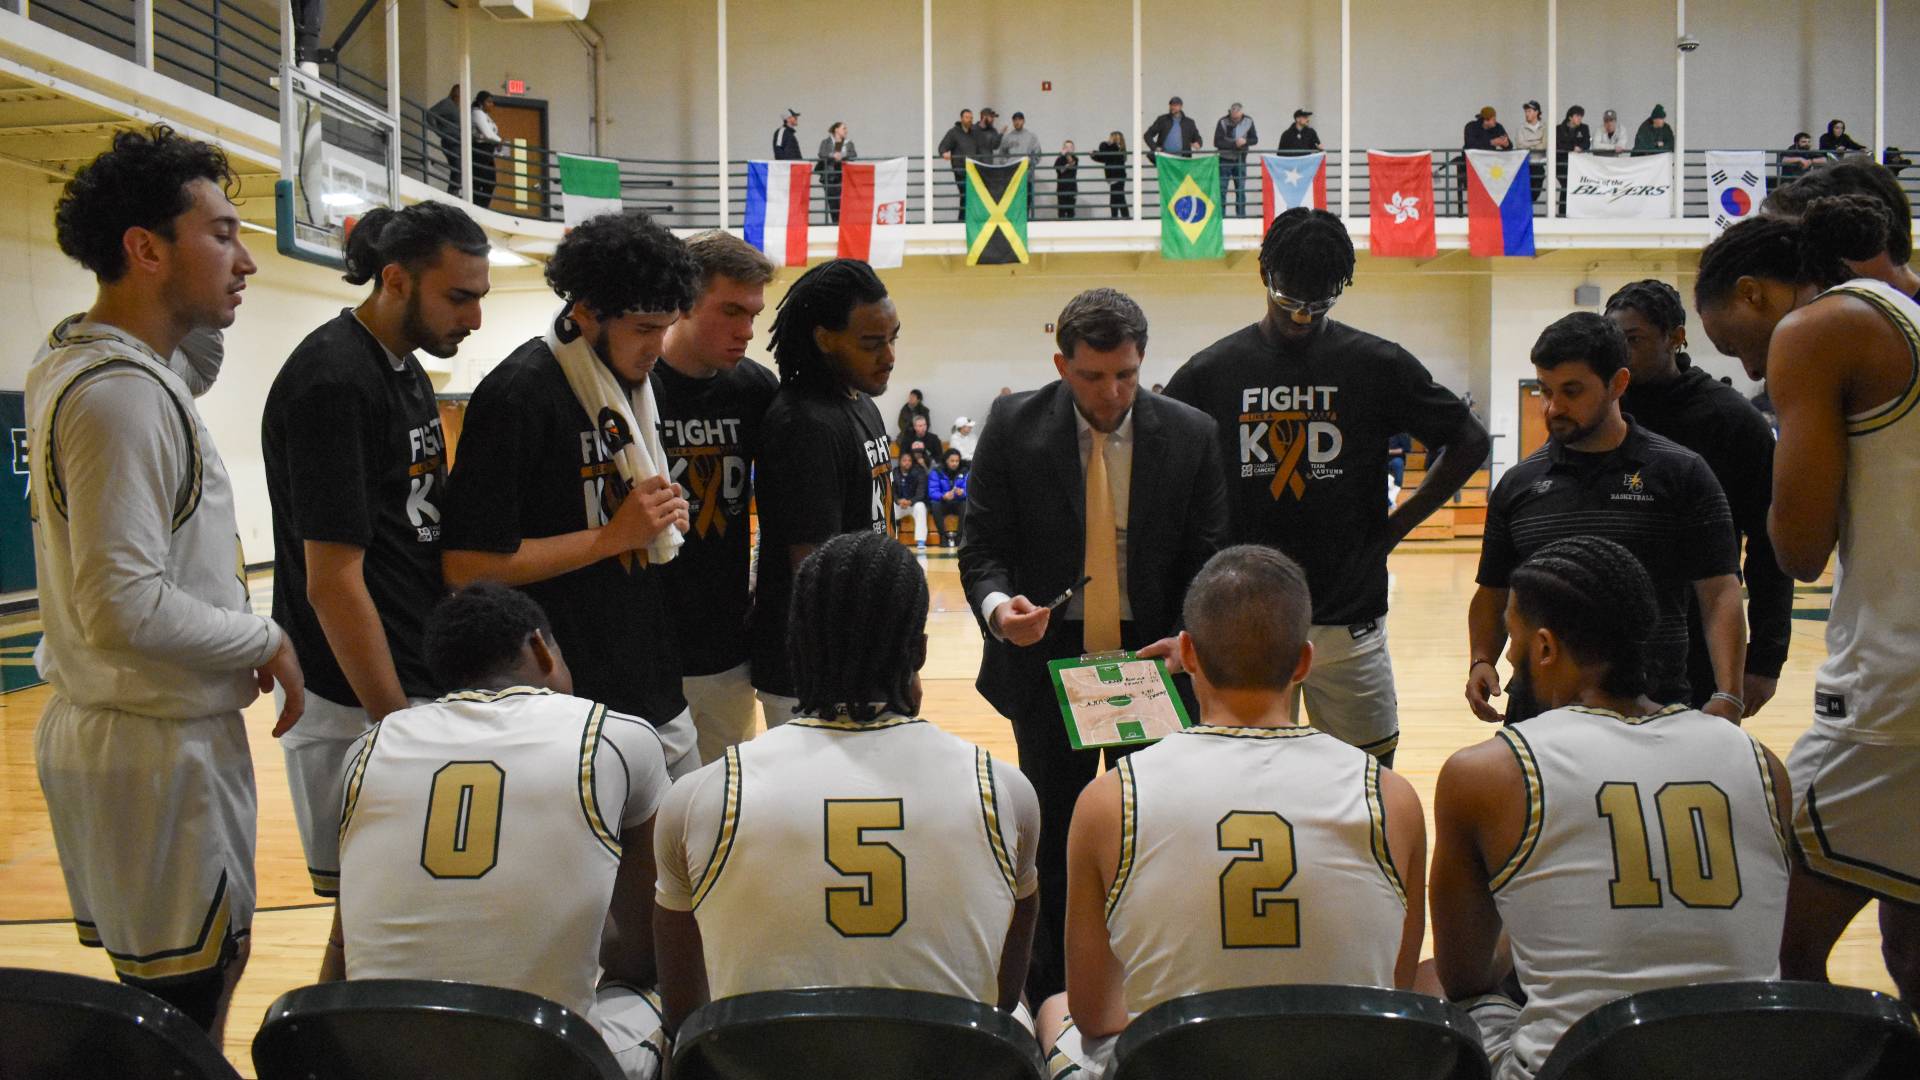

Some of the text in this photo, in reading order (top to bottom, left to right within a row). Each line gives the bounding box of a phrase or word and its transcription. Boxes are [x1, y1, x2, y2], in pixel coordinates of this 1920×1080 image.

[1602, 178, 1611, 186] of
[1241, 385, 1338, 412] FIGHT
[1610, 493, 1655, 501] BASKETBALL
[420, 760, 506, 879] 0
[823, 798, 908, 938] 5
[1216, 809, 1301, 949] 2
[1595, 780, 1743, 909] 10
